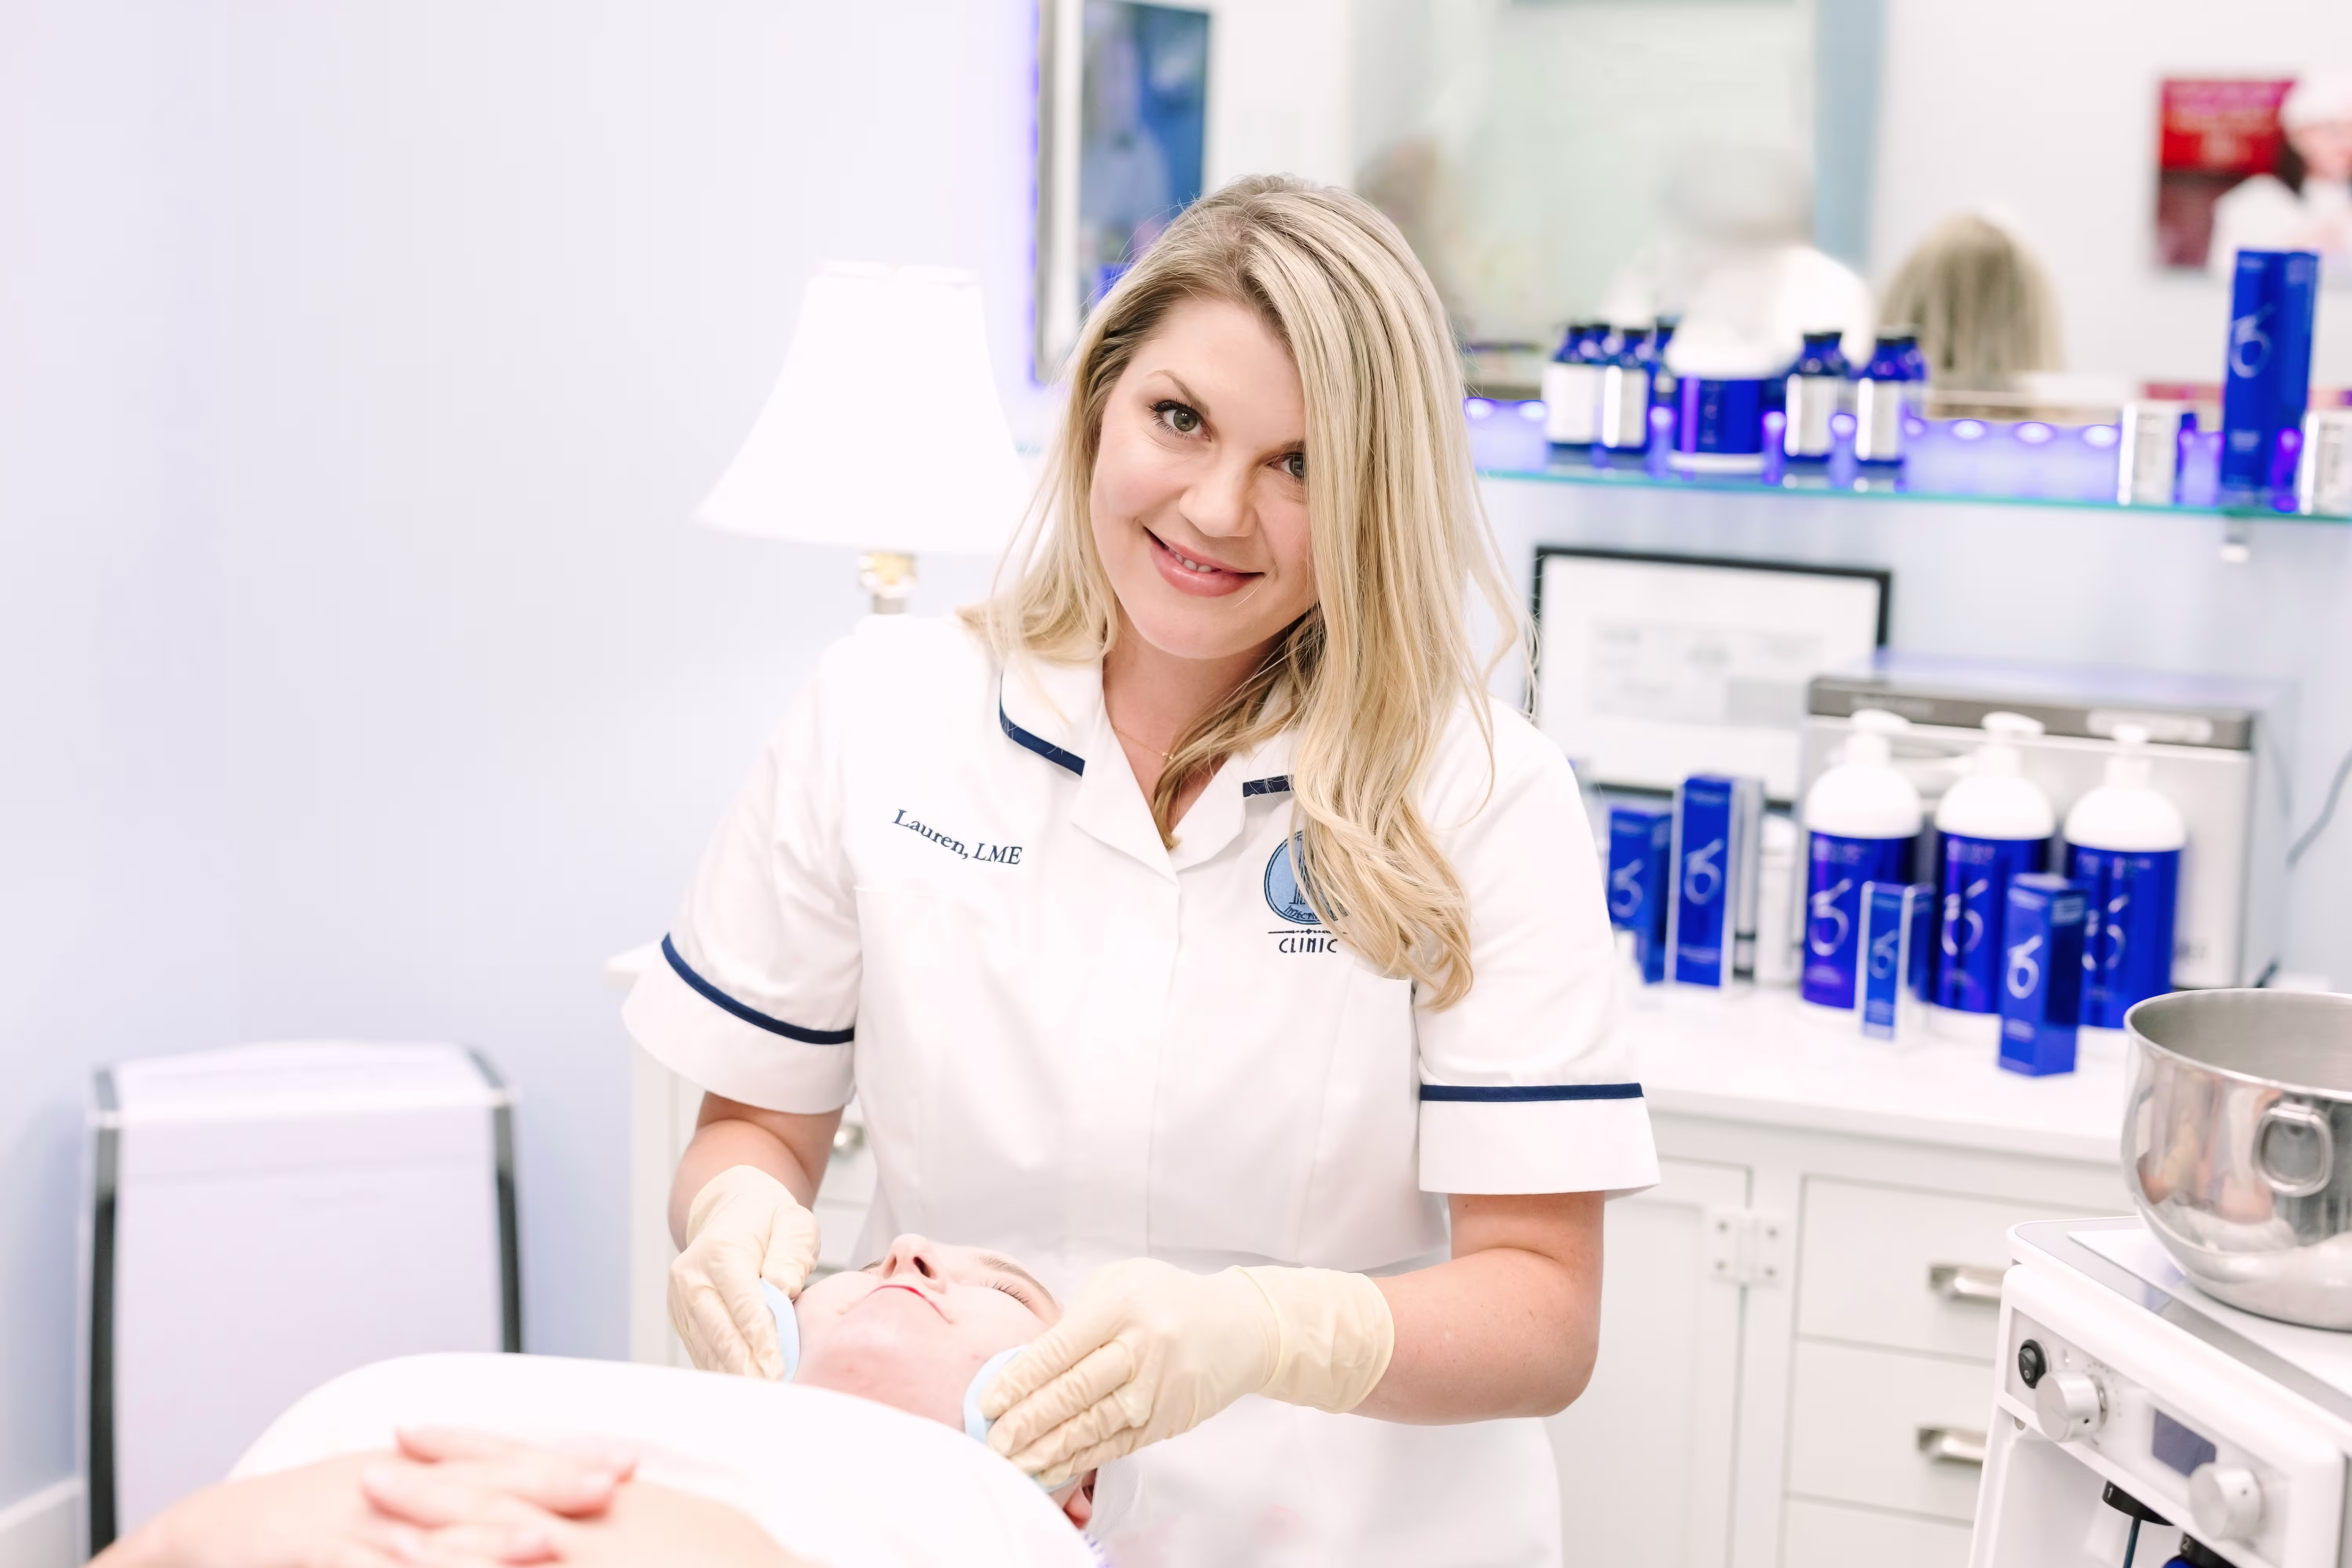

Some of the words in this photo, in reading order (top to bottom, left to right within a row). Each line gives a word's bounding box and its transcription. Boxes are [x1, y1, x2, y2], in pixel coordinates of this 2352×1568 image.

[892, 809, 969, 860] Lauren,
[972, 842, 1022, 864] LME
[1279, 937, 1338, 953] CLINIC
